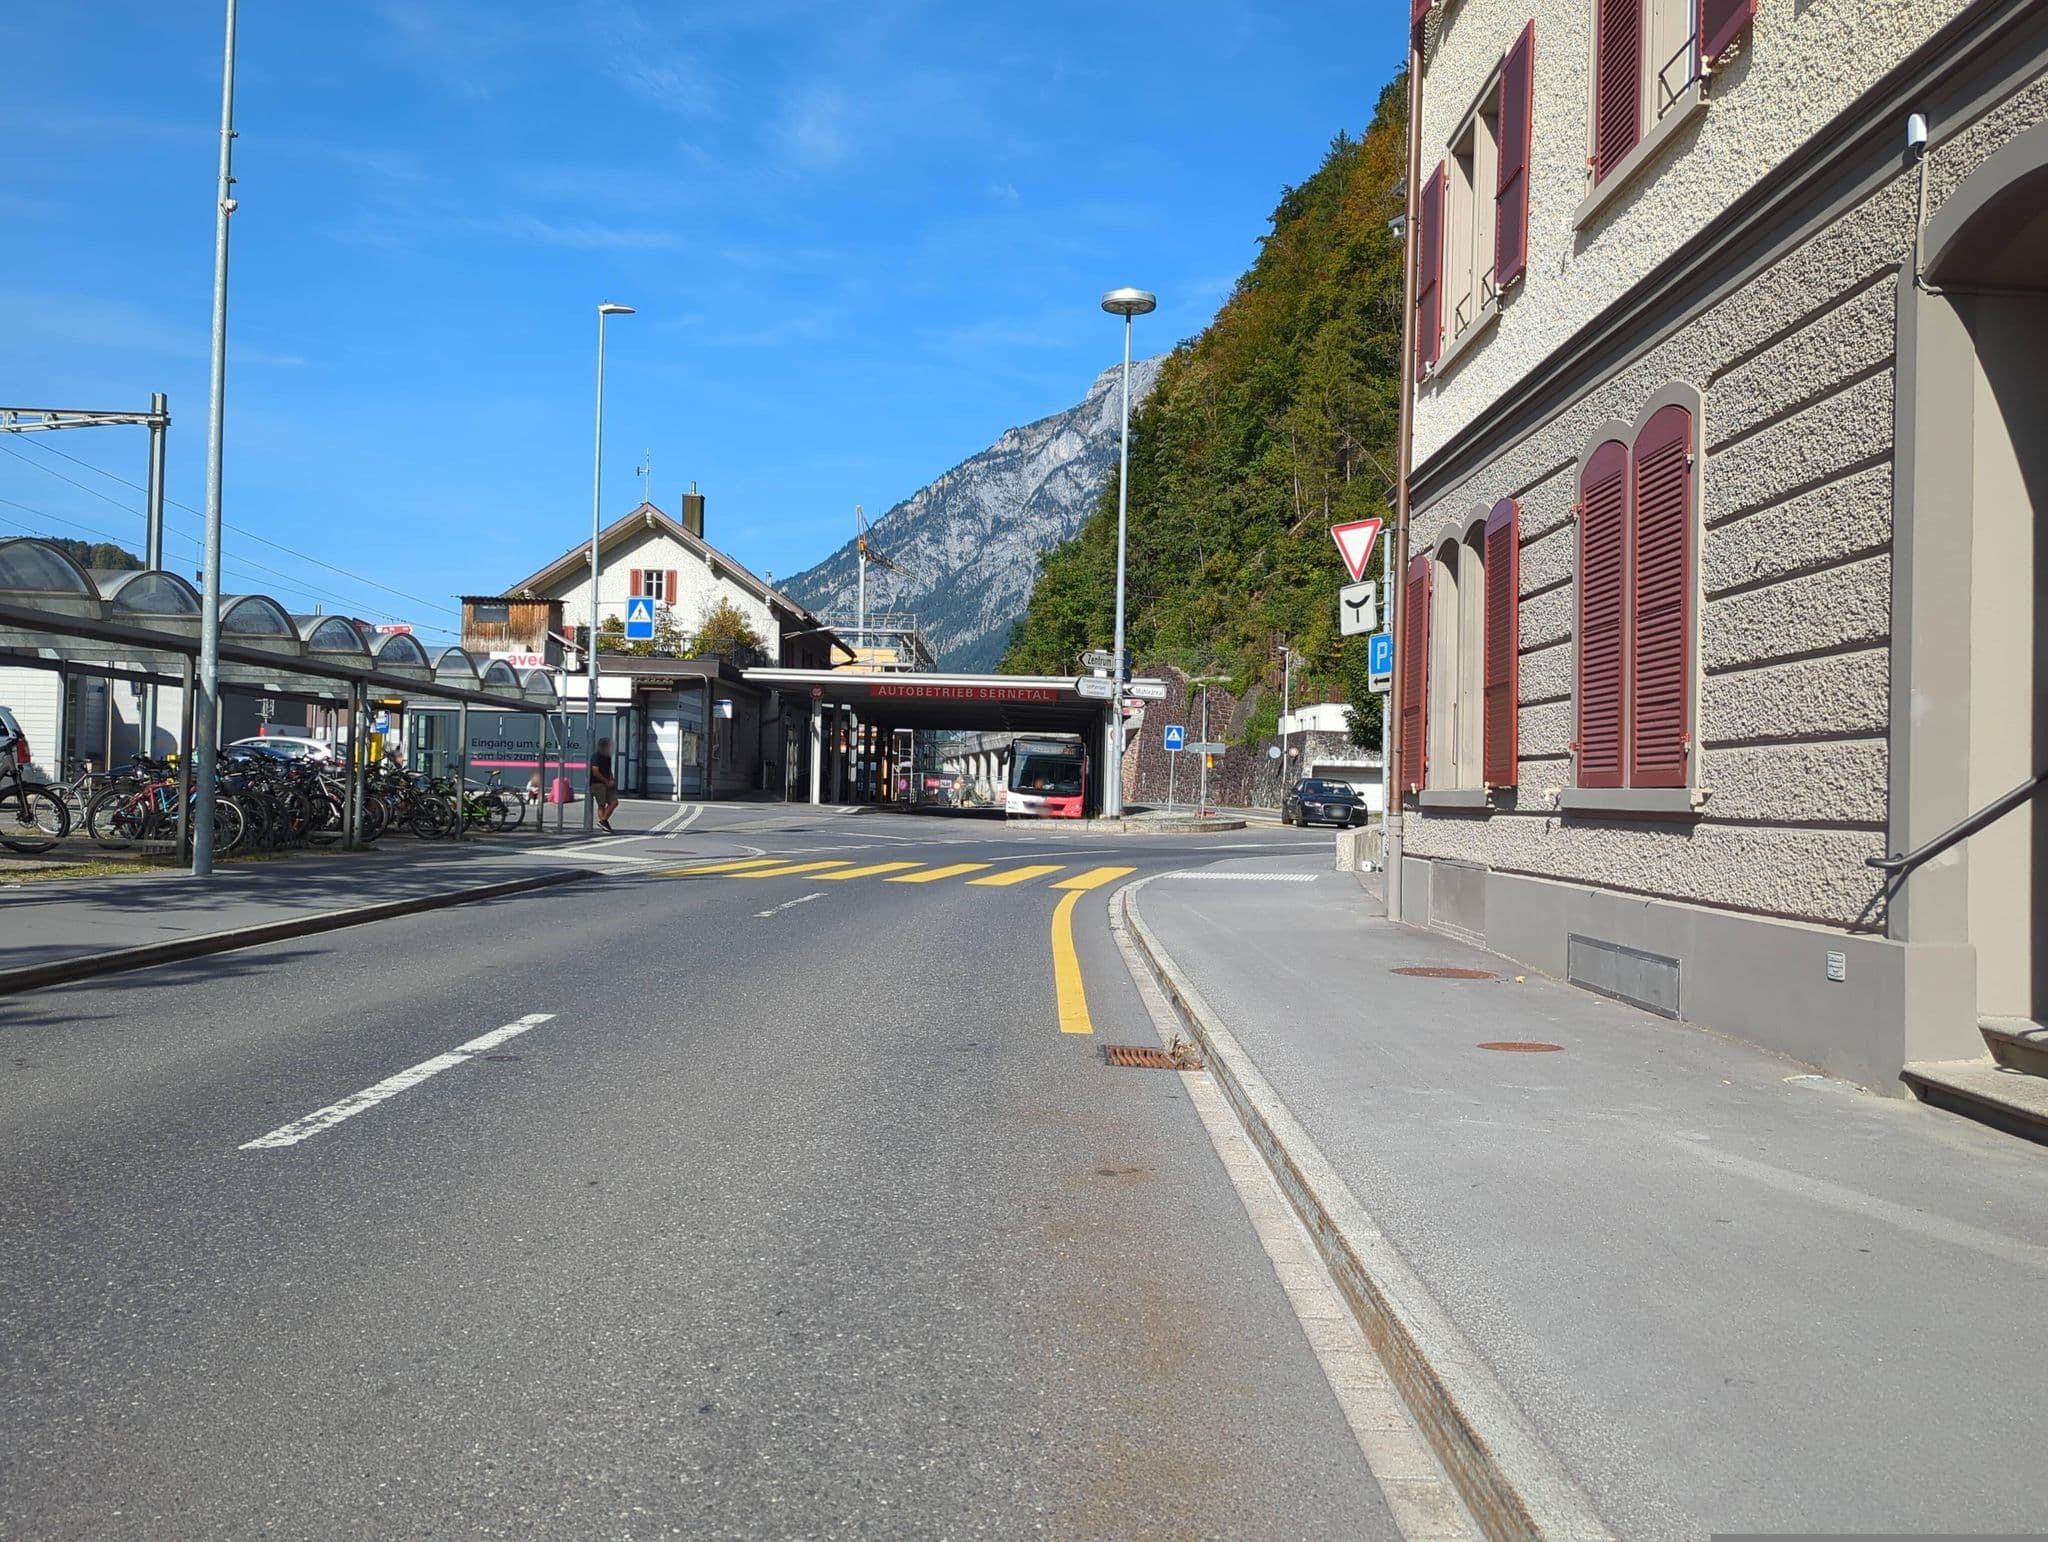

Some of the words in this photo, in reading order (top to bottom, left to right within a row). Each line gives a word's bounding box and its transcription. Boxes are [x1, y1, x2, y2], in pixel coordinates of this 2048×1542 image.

[1087, 653, 1112, 667] Zentrum
[1376, 641, 1388, 670] P
[878, 685, 973, 698] AUTOBETRIEB
[979, 688, 1050, 700] SERNFTAL
[471, 738, 513, 750] Eingang
[516, 740, 534, 748] um
